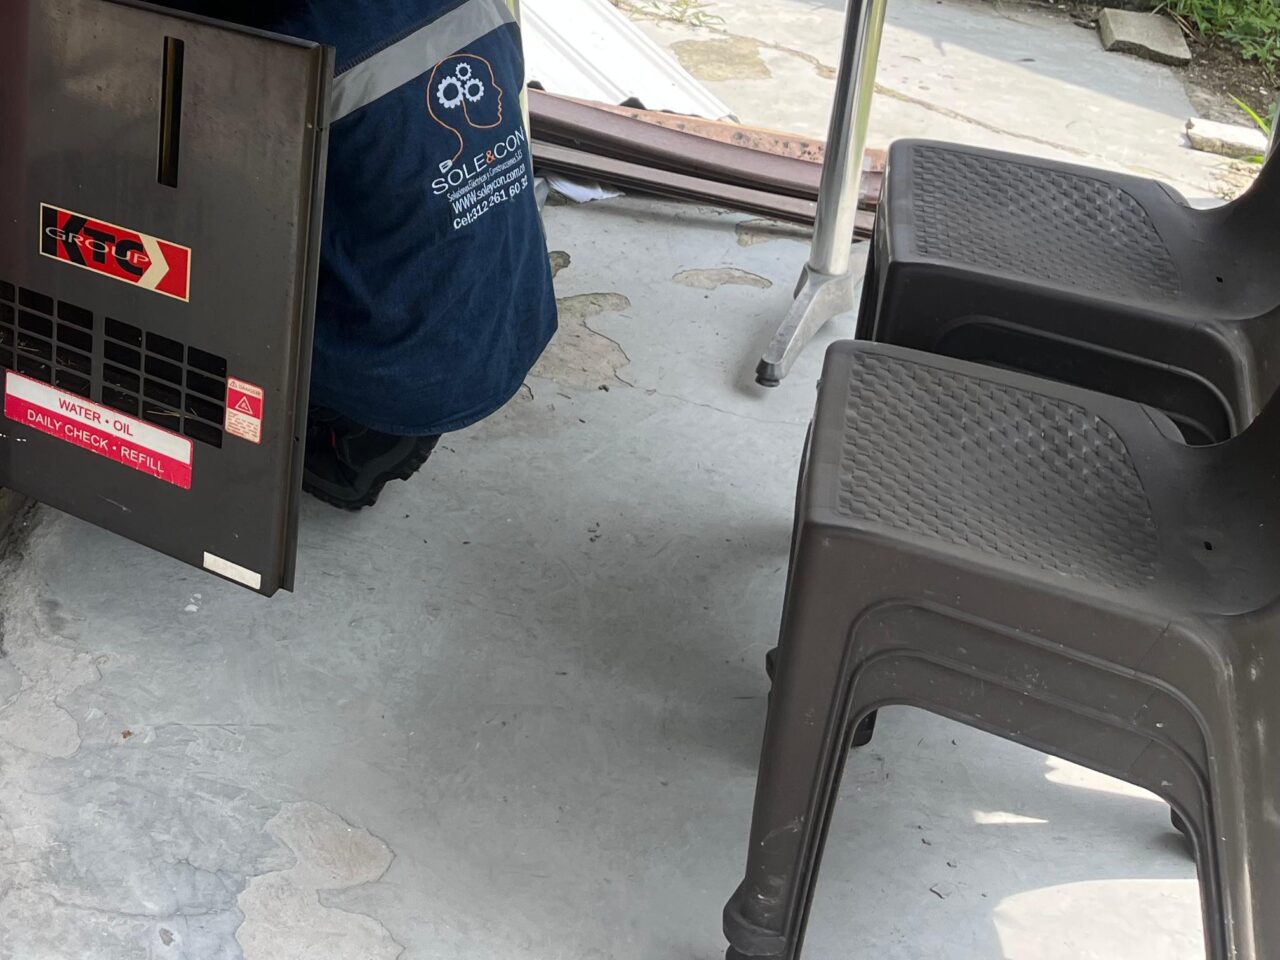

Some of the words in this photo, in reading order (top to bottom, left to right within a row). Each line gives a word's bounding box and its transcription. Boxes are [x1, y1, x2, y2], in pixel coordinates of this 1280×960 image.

[431, 126, 525, 195] SOLE&CON
[489, 189, 508, 207] 261
[509, 182, 520, 197] 60
[42, 206, 144, 276] KTC
[45, 227, 149, 264] GROUP
[27, 409, 62, 431] DAILY
[65, 424, 109, 451] CHECK
[121, 446, 165, 473] REFILL
[58, 398, 101, 424] WATER
[113, 420, 133, 437] OIL
